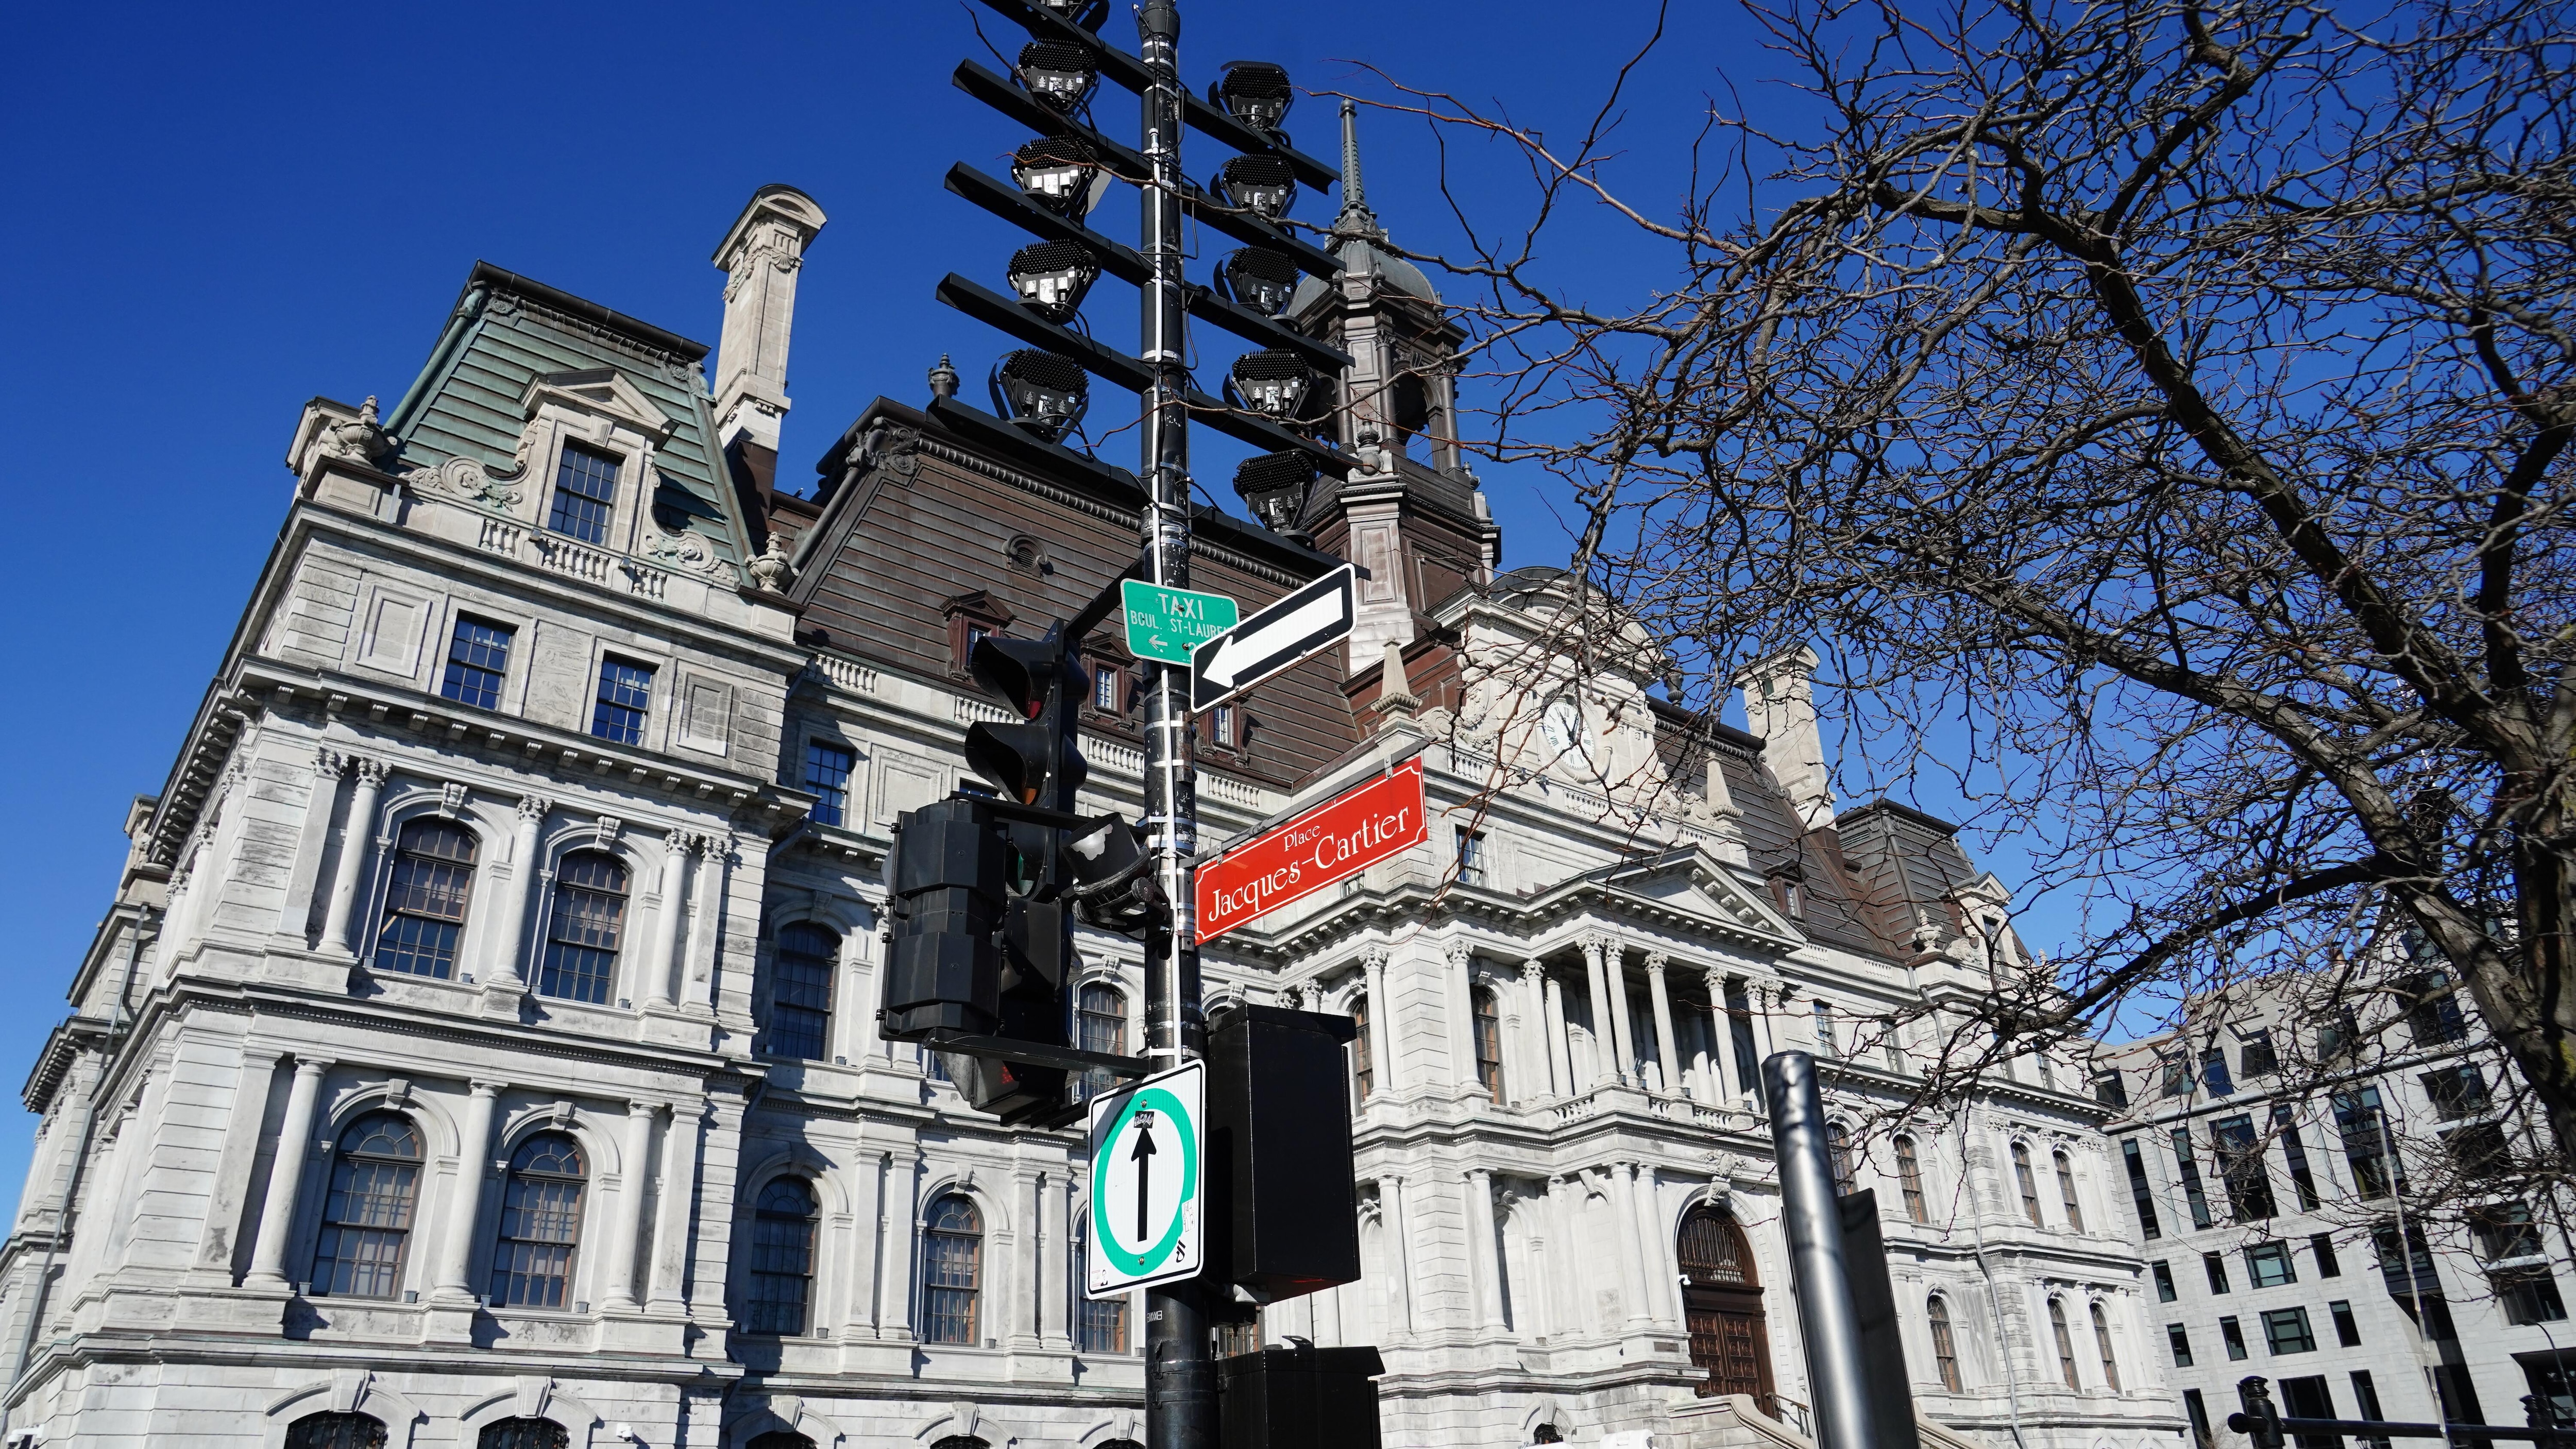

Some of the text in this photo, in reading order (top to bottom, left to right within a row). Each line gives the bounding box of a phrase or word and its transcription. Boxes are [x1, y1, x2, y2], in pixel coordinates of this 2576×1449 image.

[1158, 593, 1204, 620] TAXI
[1284, 825, 1321, 852] Place
[1208, 806, 1409, 922] Jacques-Cartier
